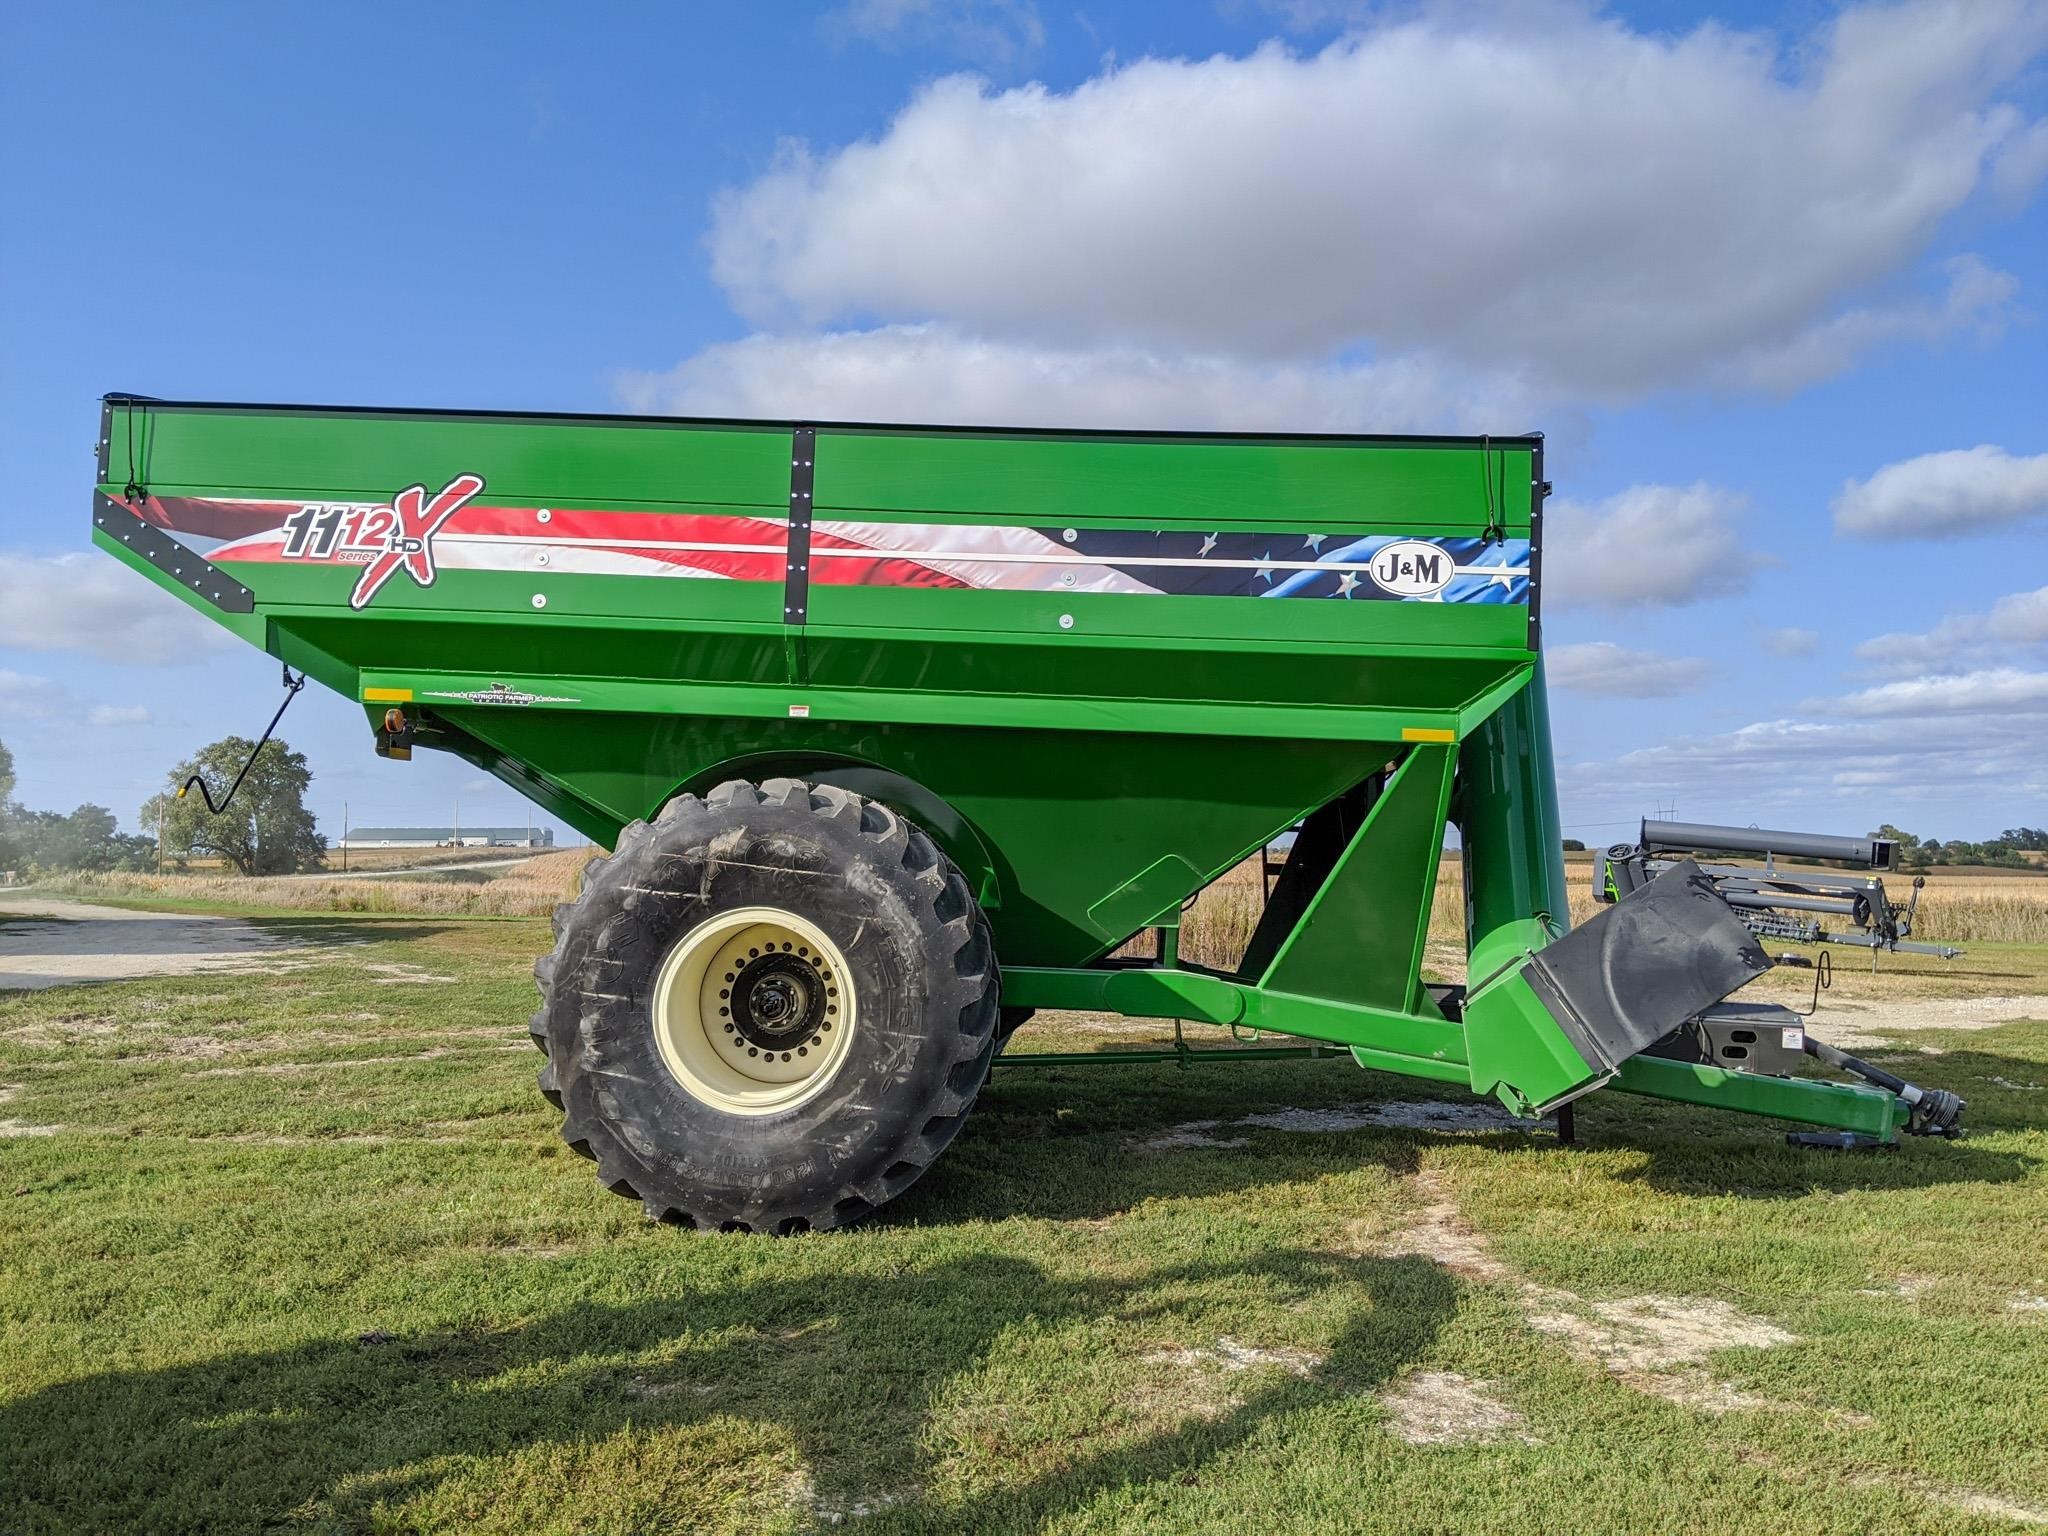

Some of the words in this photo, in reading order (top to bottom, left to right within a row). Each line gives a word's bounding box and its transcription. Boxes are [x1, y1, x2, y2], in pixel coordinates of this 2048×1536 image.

[391, 537, 422, 552] HD
[338, 550, 376, 562] series
[1378, 553, 1441, 584] J&M
[468, 693, 504, 701] PATRIOTIC
[505, 694, 534, 703] FARMER
